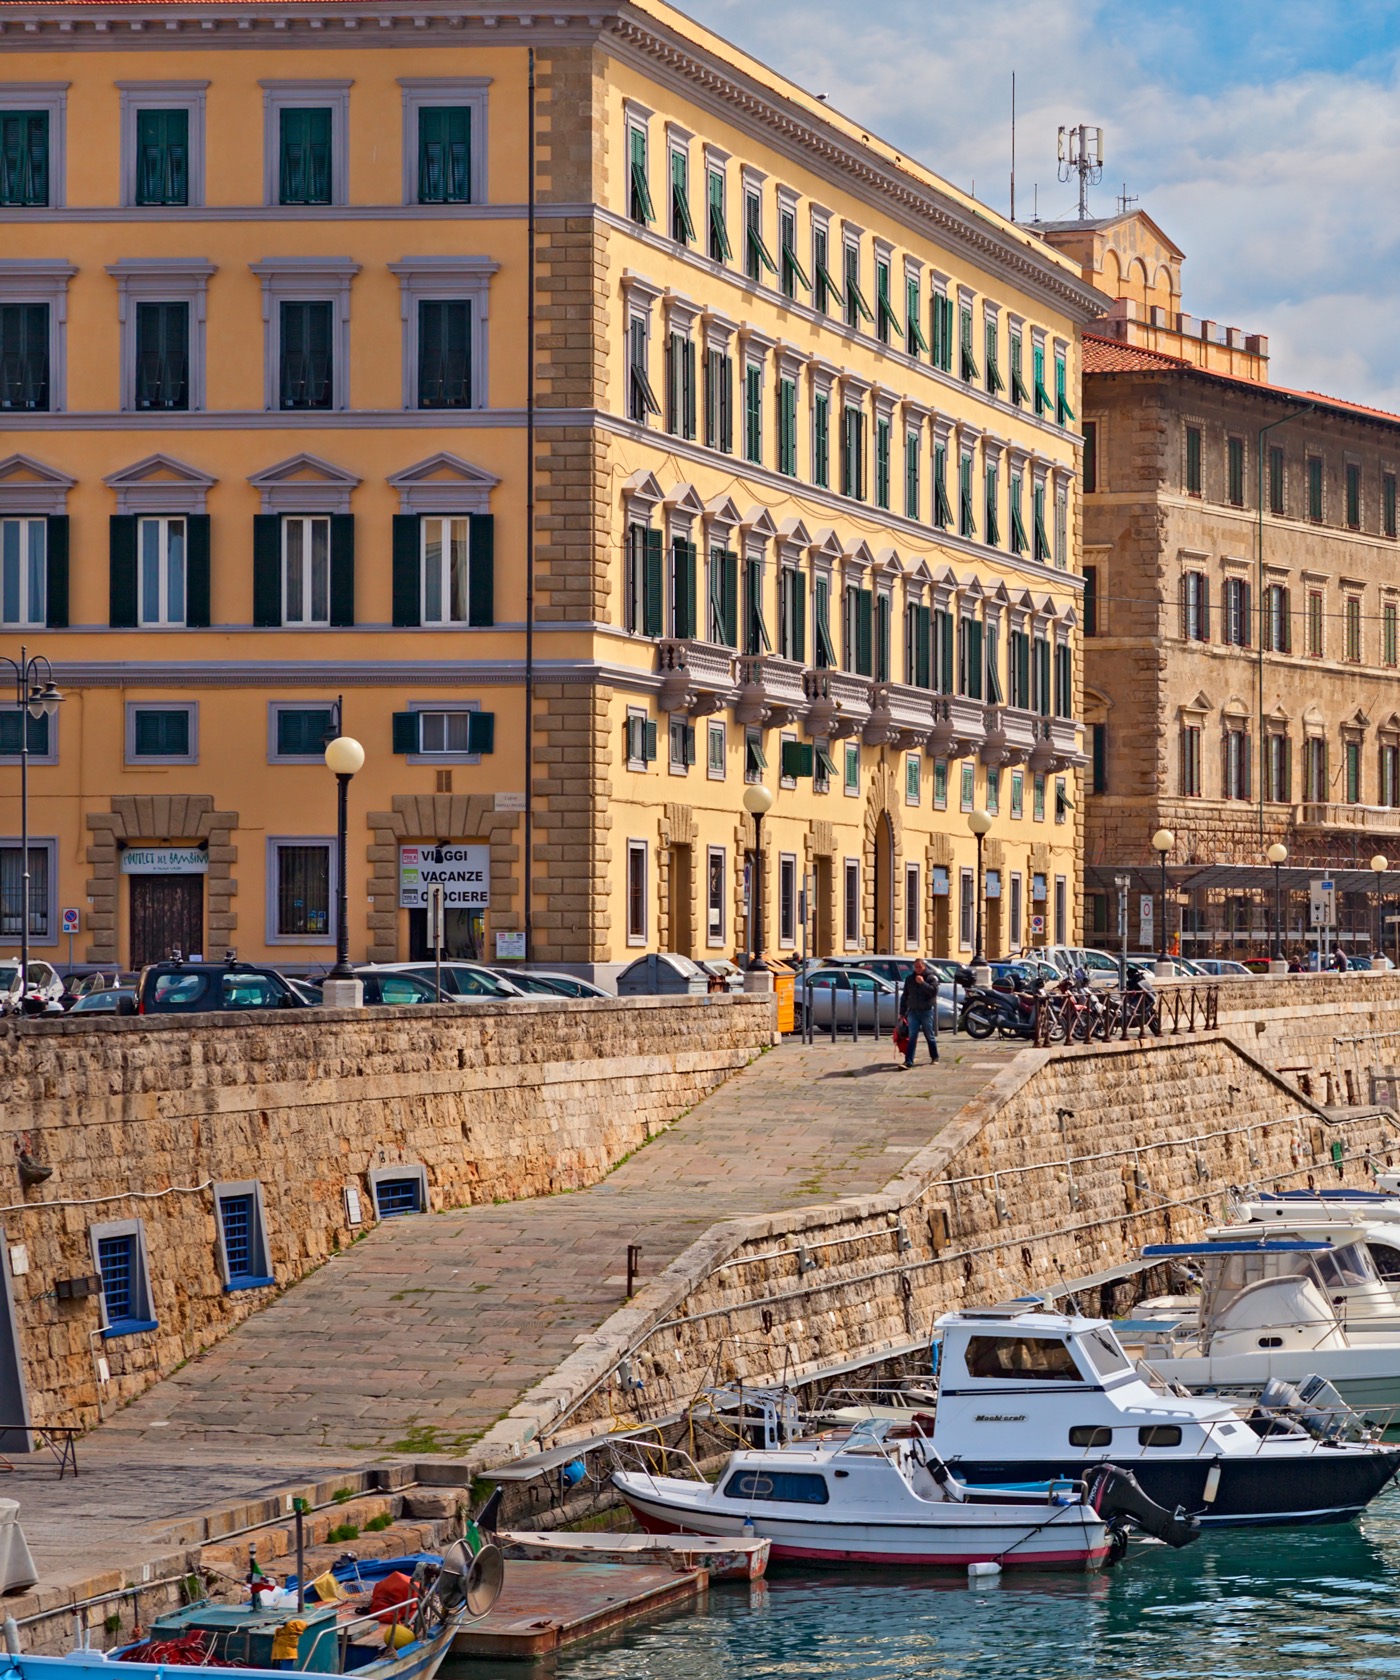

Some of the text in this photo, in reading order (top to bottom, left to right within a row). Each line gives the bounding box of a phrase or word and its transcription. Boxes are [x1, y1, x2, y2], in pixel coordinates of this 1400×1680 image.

[123, 852, 154, 865] L'OUTLET
[421, 850, 467, 861] VIGGI
[421, 871, 483, 882] VACANZE
[420, 891, 488, 902] CCIERE
